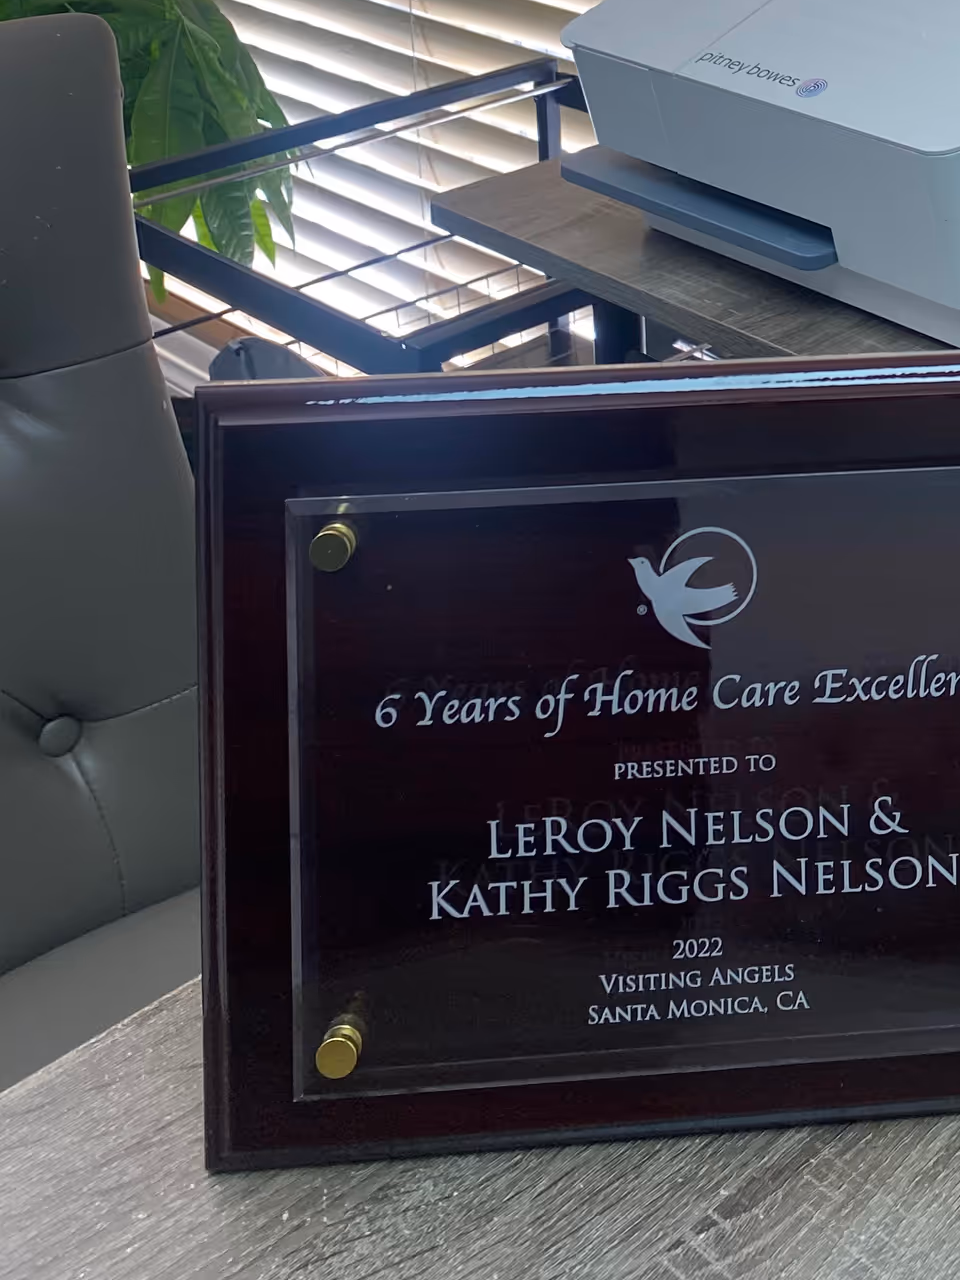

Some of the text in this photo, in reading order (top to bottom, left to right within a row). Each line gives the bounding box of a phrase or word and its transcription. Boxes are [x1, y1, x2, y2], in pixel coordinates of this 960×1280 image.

[695, 52, 801, 87] pitney bowes
[374, 694, 402, 728] 6
[414, 690, 522, 727] Years
[535, 674, 580, 738] of
[584, 669, 698, 717] Home
[712, 674, 800, 710] Care
[613, 754, 777, 780] PRESENTED TO
[869, 796, 910, 835] &
[672, 937, 723, 960] 2022
[776, 990, 811, 1011] CA
